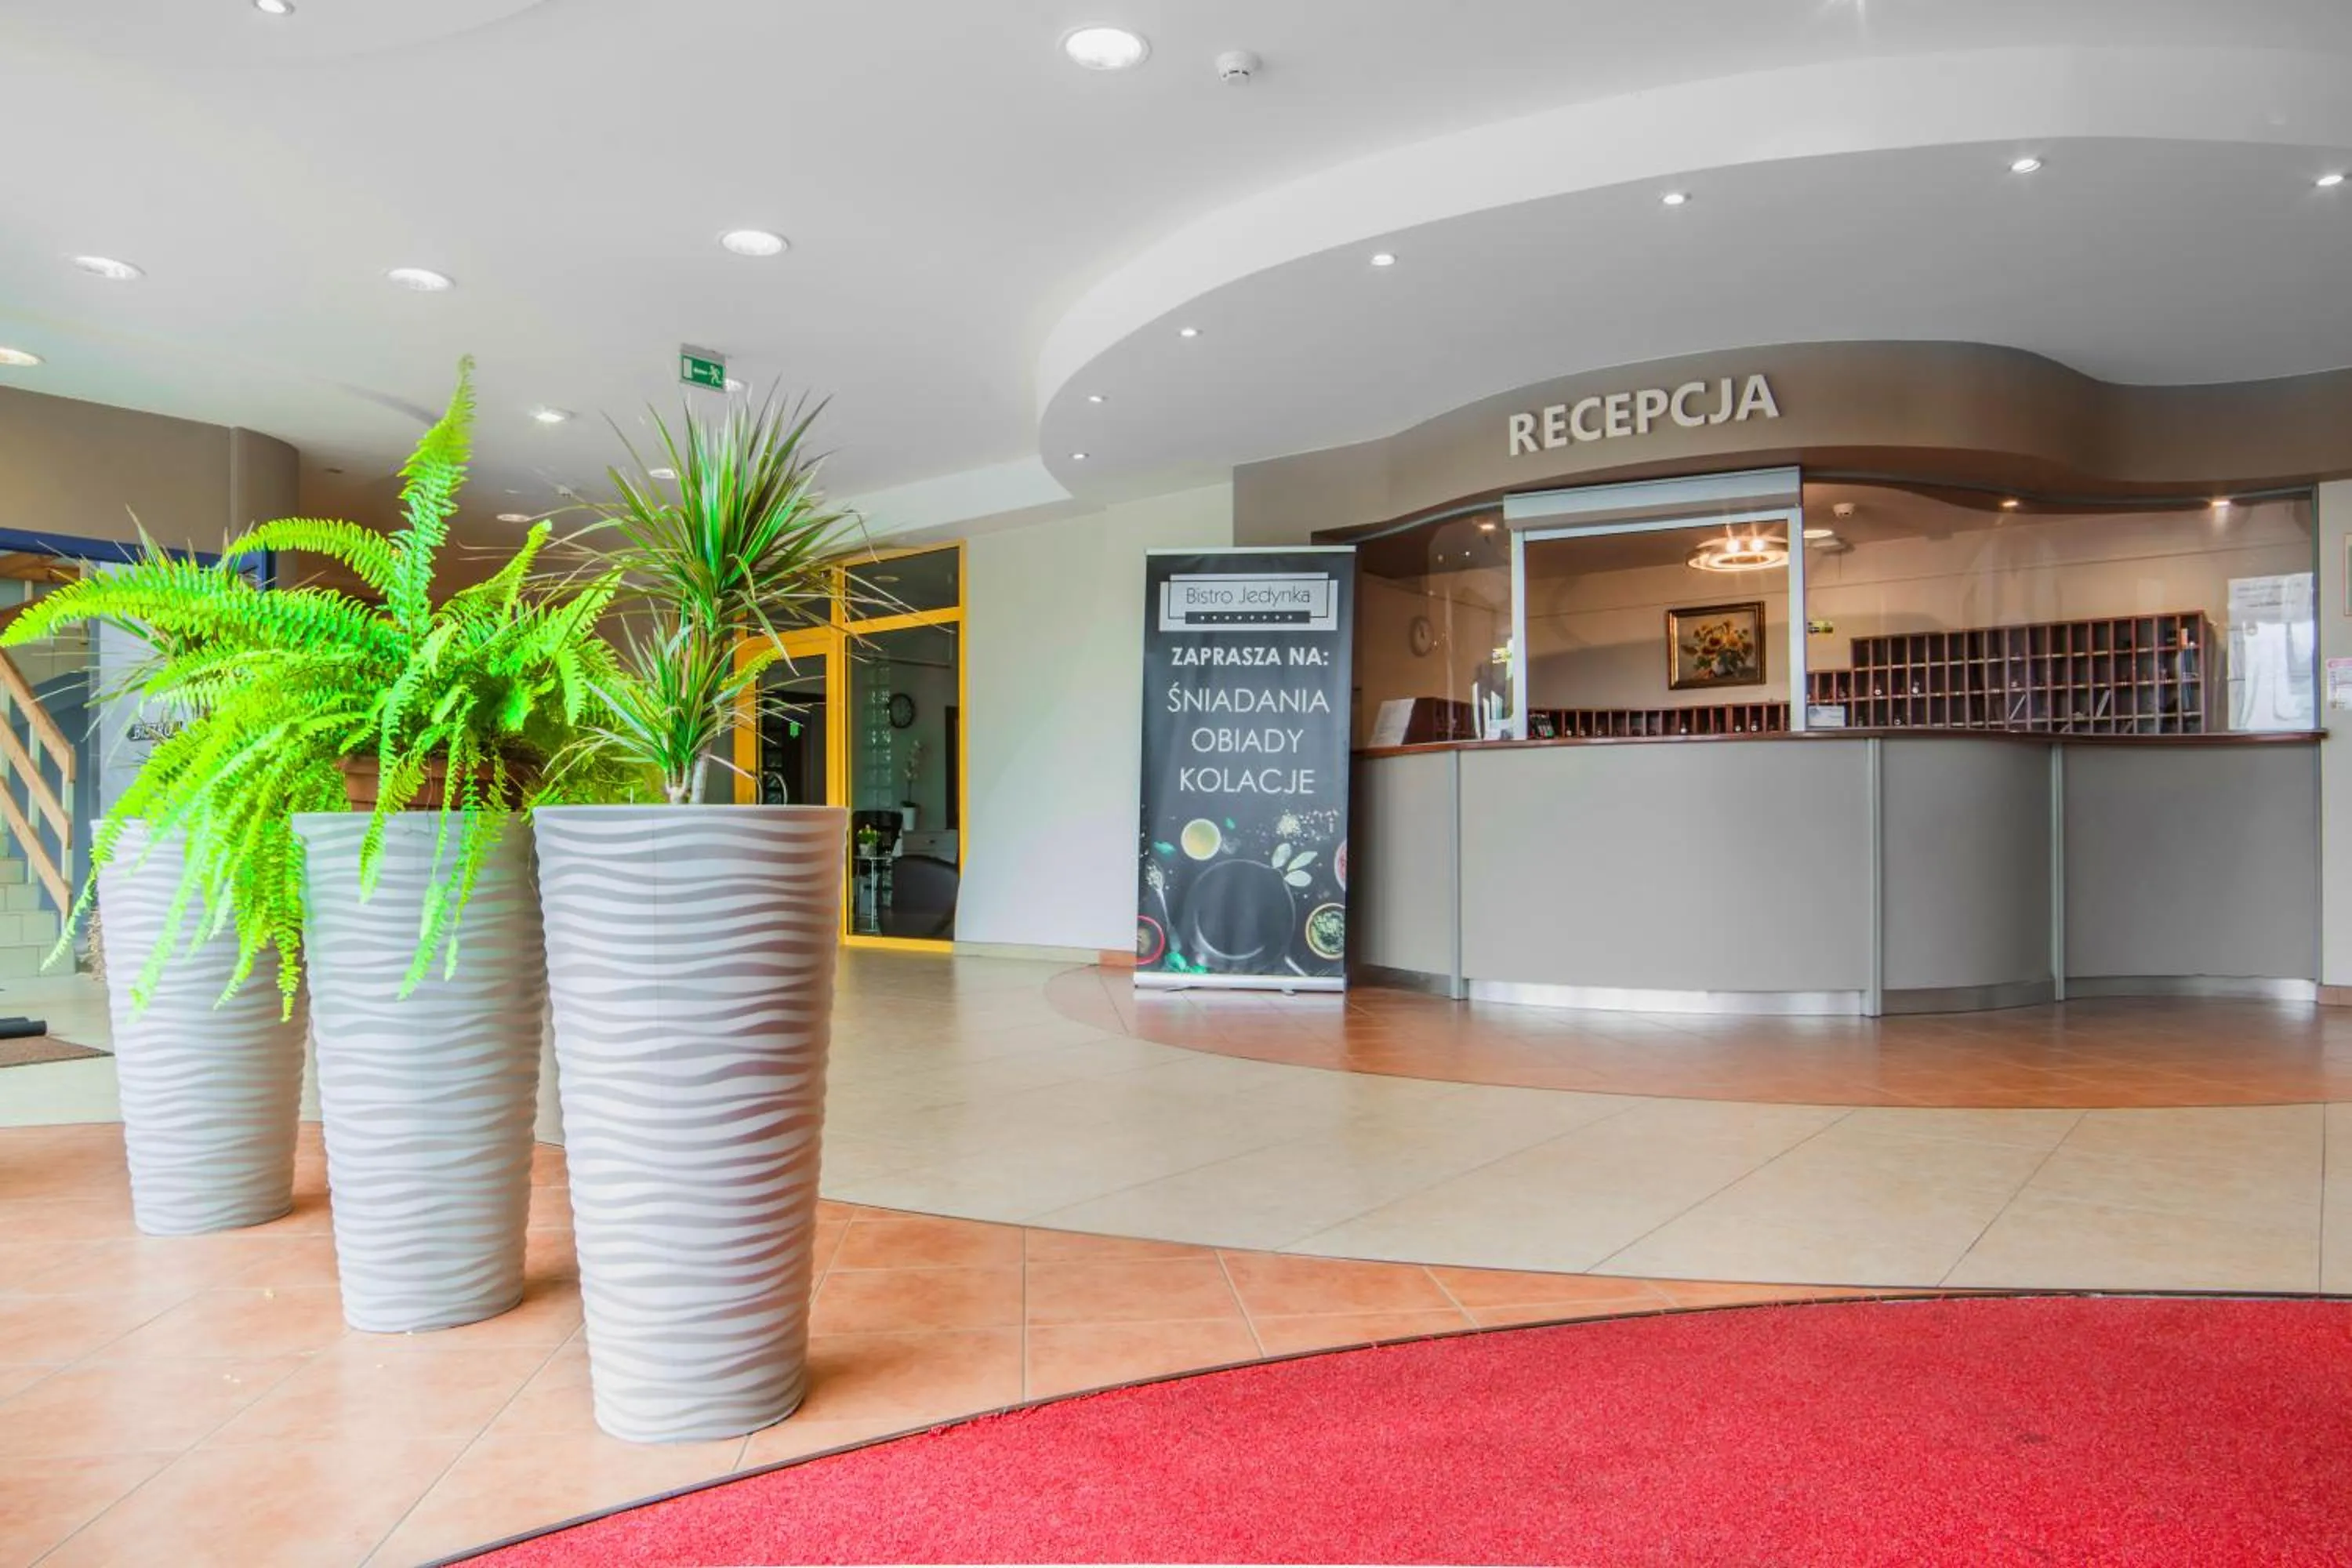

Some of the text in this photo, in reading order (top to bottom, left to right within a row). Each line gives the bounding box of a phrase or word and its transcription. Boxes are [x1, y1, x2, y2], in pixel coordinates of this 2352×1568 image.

[1509, 374, 1780, 456] RECEPCJA
[1186, 586, 1311, 608] Bistro Jedynka
[1171, 647, 1330, 666] ZAPRASZA NA:
[1167, 681, 1330, 713] ŚNIADANIA
[1192, 728, 1304, 753] OBIADY
[1180, 768, 1316, 793] KOLACJE
